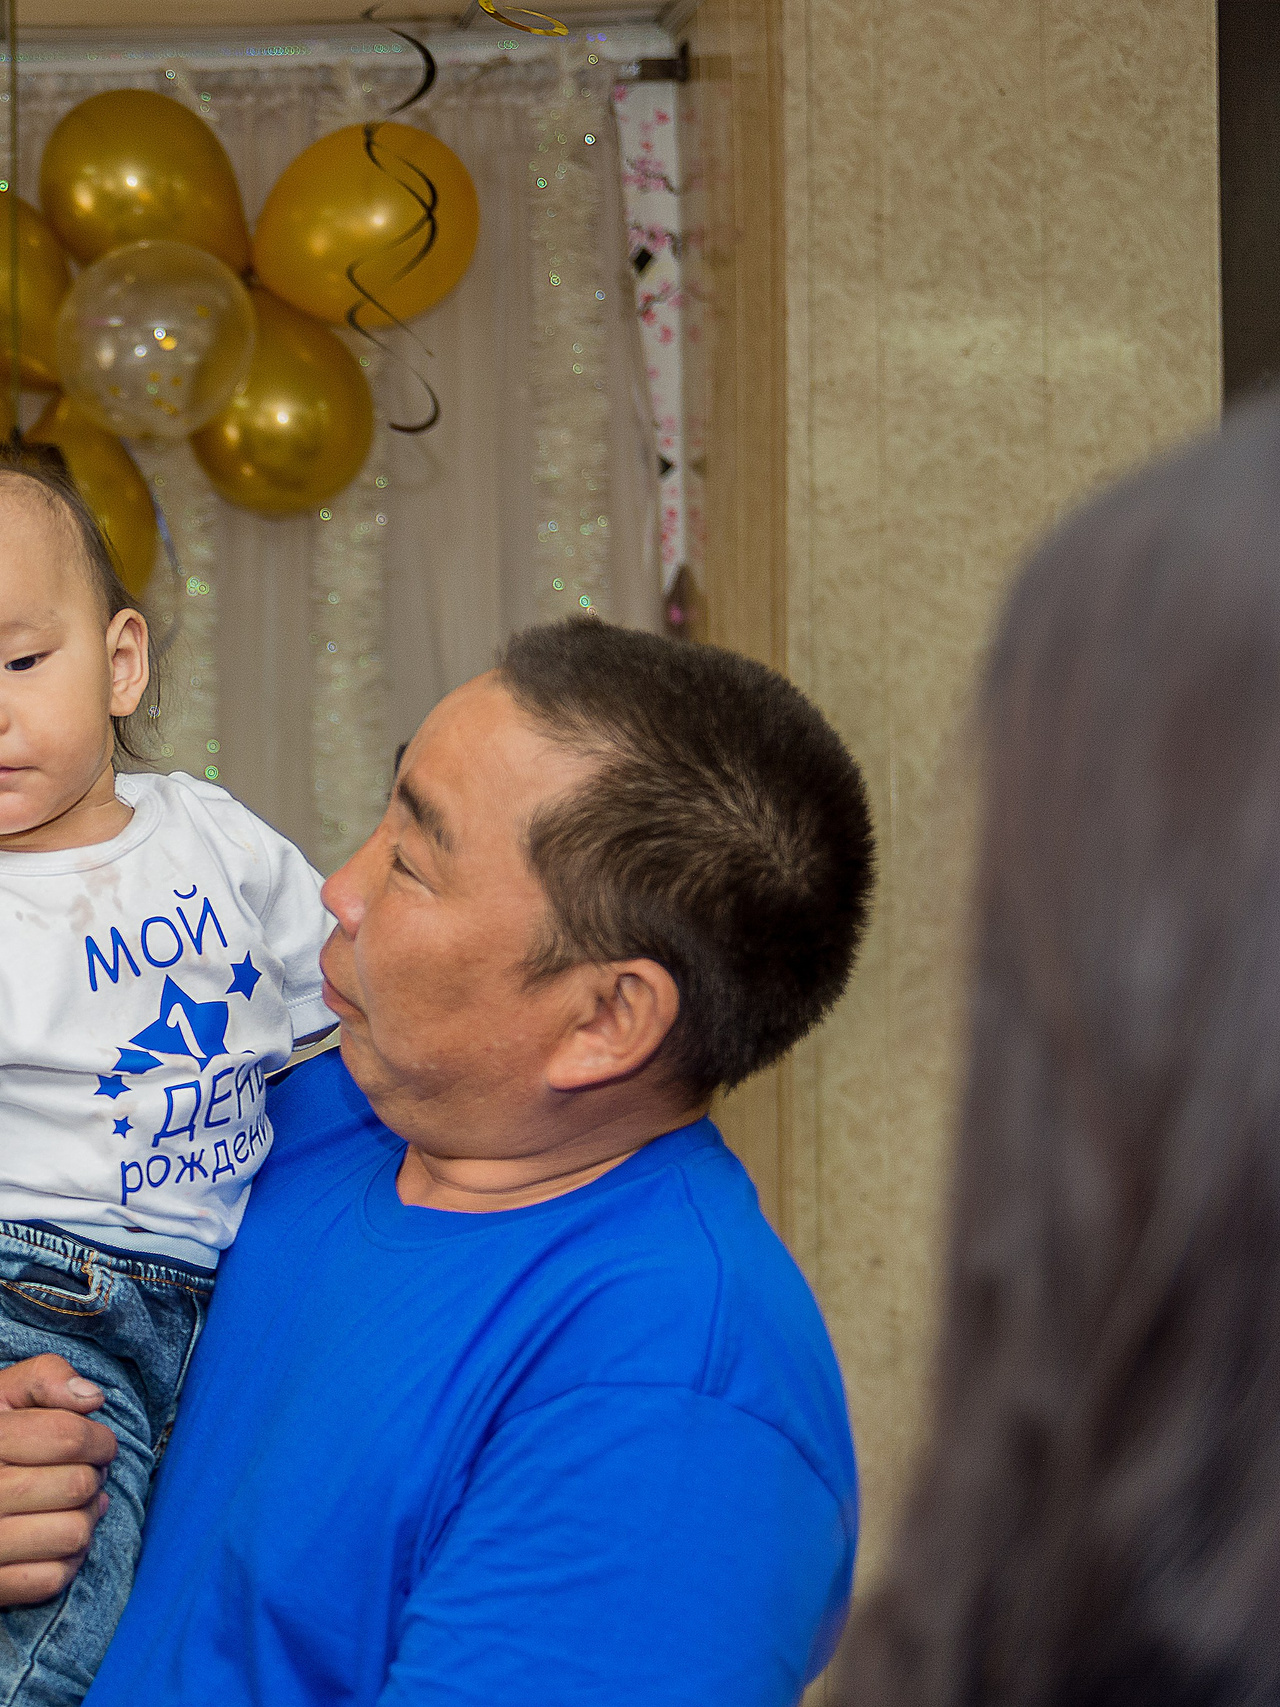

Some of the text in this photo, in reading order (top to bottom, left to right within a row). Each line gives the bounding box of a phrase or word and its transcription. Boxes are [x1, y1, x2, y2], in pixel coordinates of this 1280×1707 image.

[84, 884, 228, 992] МОЙ
[166, 1002, 208, 1059] 1
[121, 1111, 268, 1206] рождени
